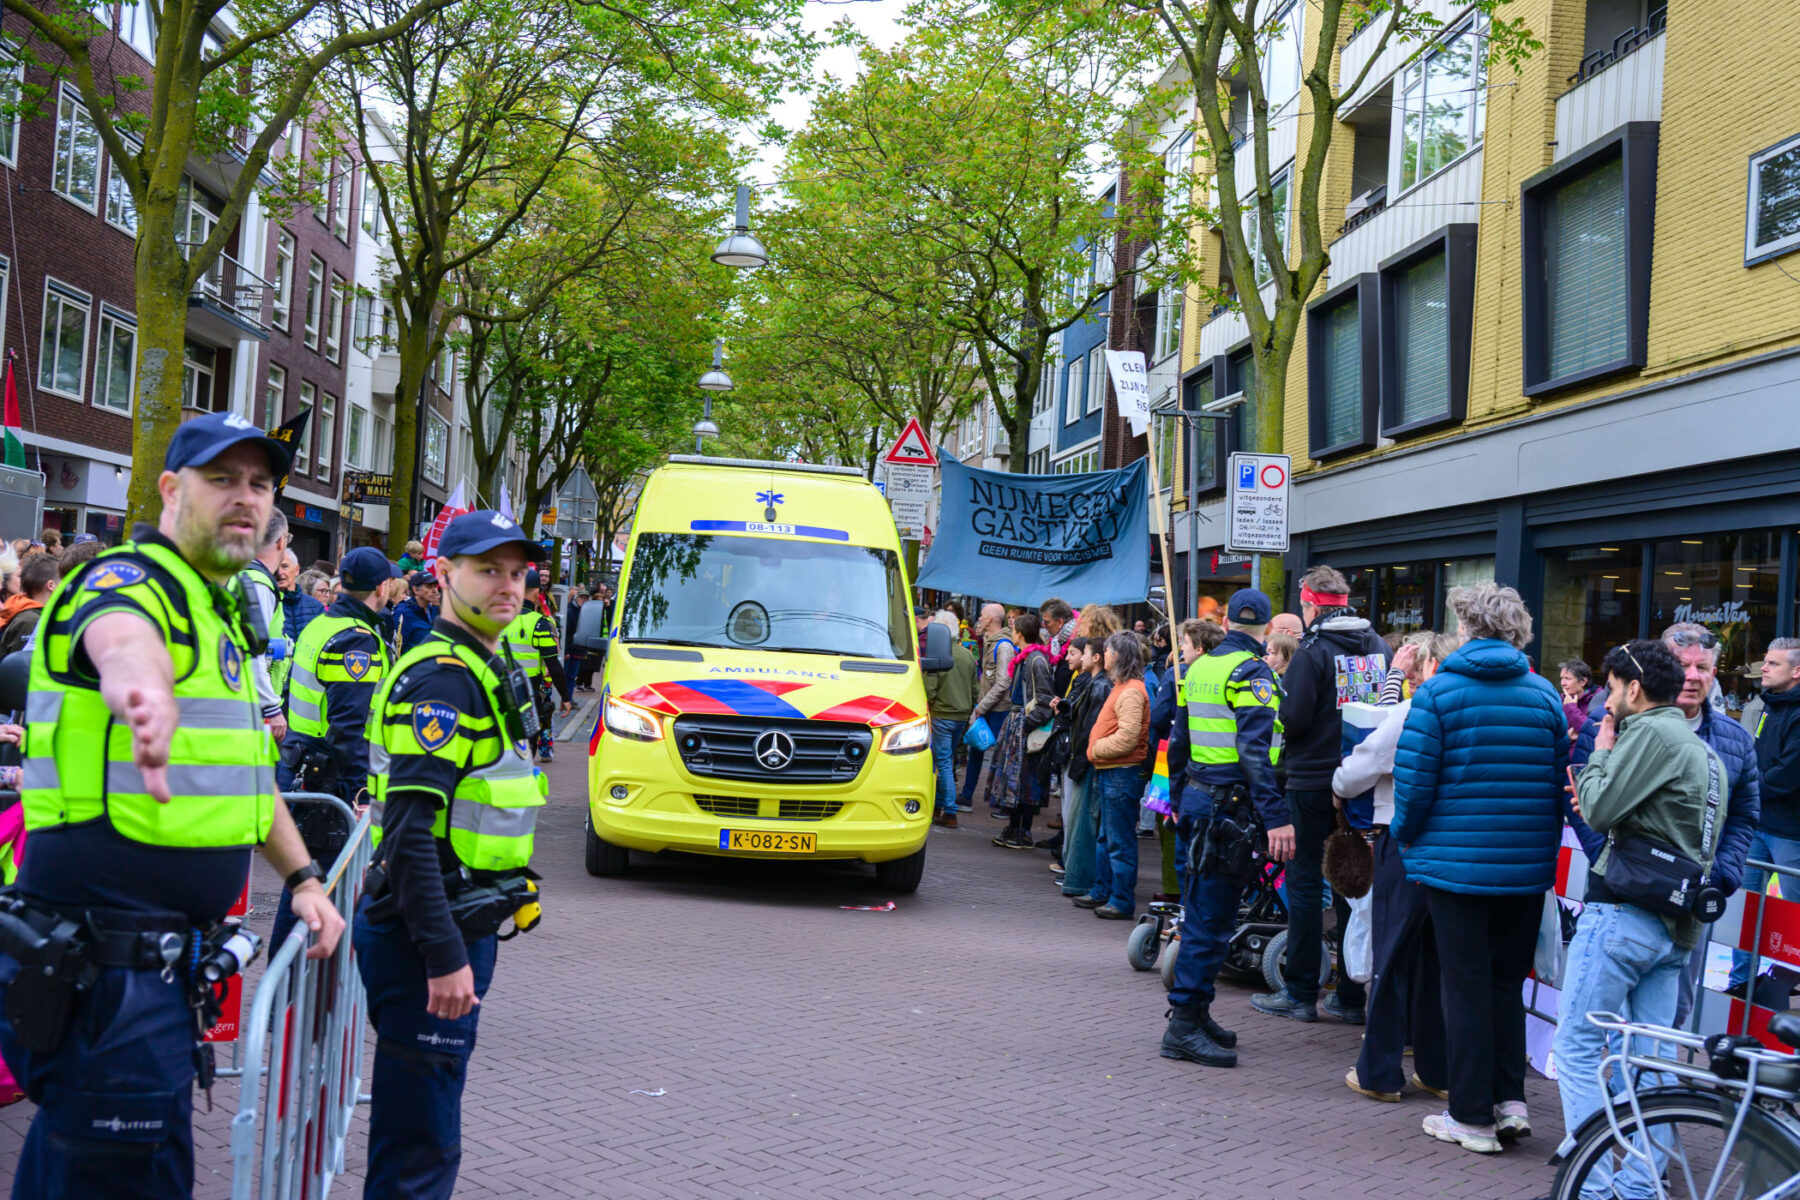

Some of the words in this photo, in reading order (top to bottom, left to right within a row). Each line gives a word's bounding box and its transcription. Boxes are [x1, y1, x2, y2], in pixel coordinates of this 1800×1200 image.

[1242, 466, 1253, 479] P
[969, 477, 1128, 520] NIJMEGEN
[1239, 494, 1283, 502] uitgezonderd
[748, 523, 791, 533] 08-113
[972, 507, 1120, 549] GASTVRIJ
[1237, 531, 1281, 539] uitgezonderd
[1233, 538, 1255, 546] tijdens
[982, 543, 1008, 557] GEEN
[1010, 548, 1042, 561] RUIMTE
[1043, 552, 1062, 562] VOOR
[1063, 546, 1110, 562] RACISME!
[708, 667, 841, 680] AMBULANCE
[416, 704, 457, 721] POLITIE
